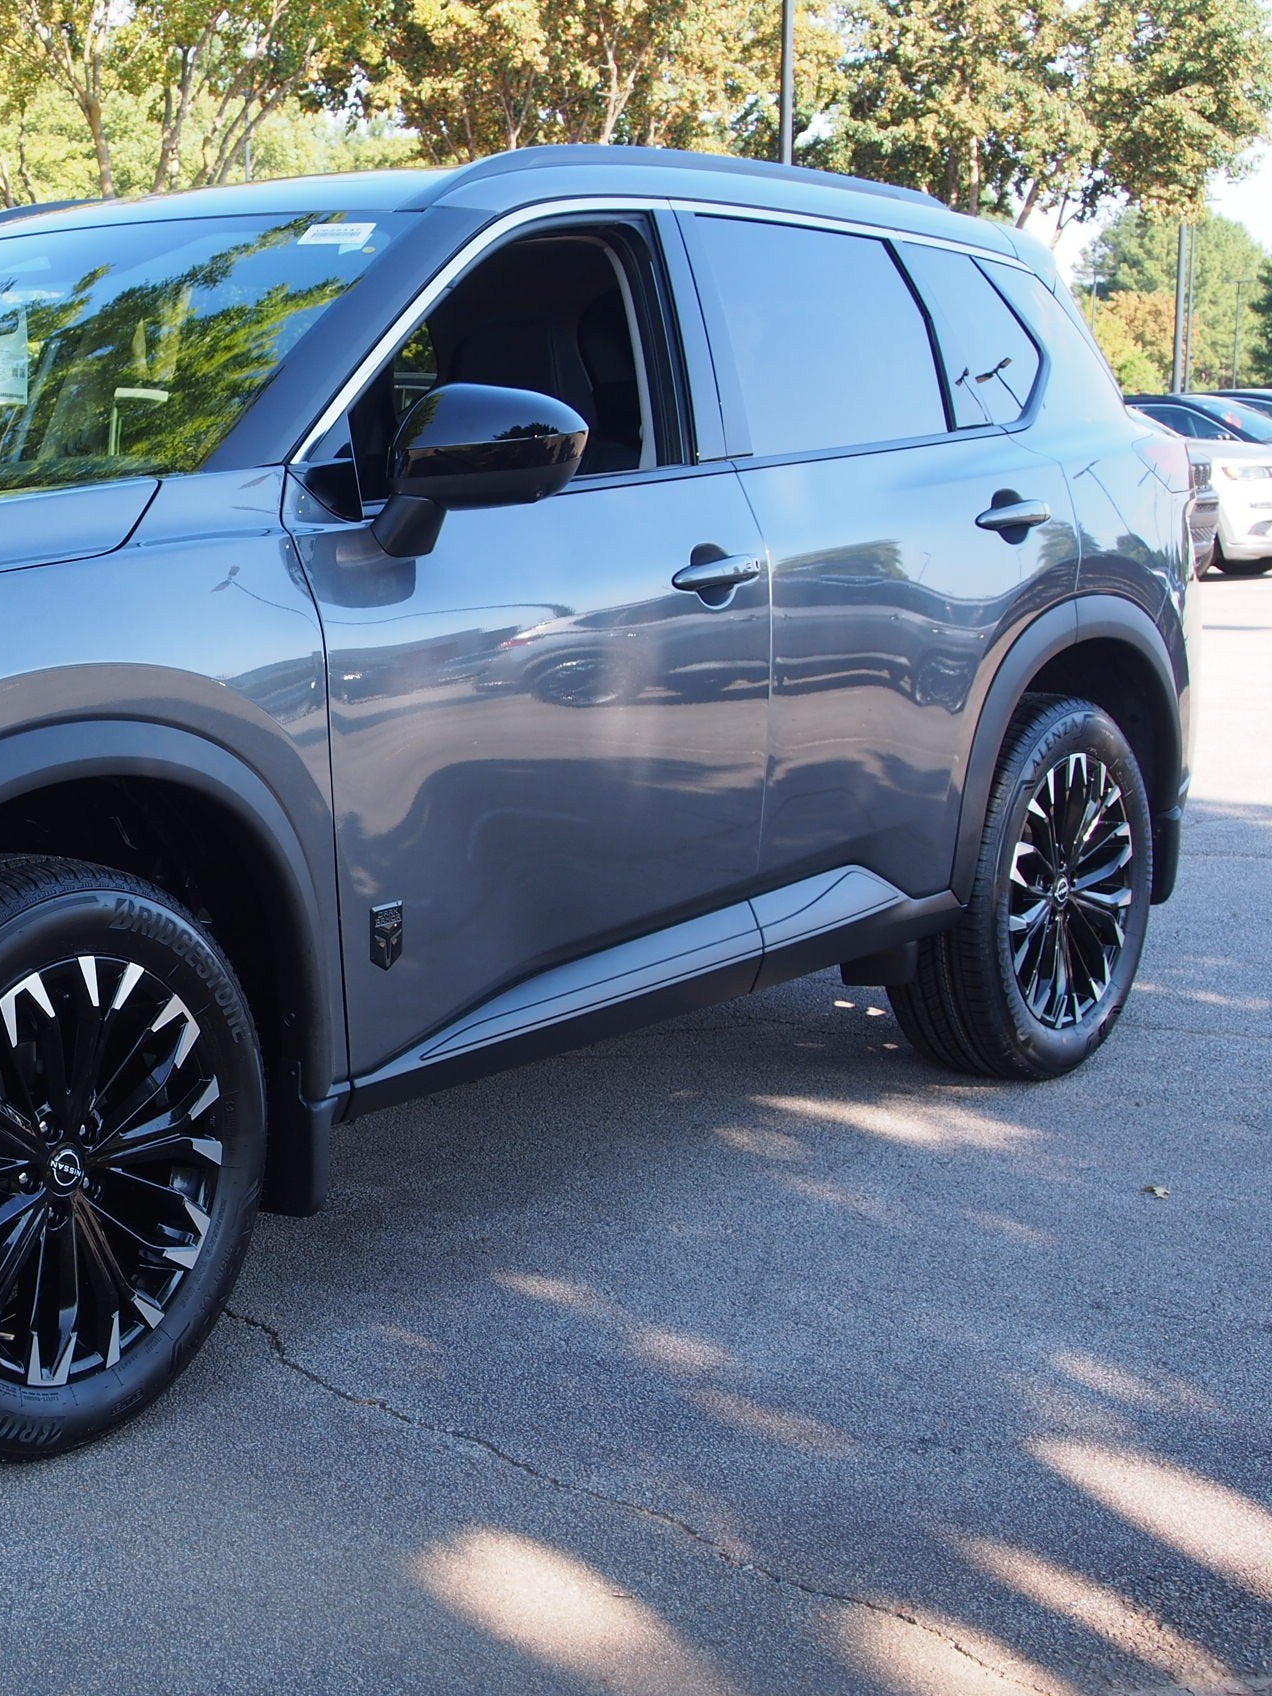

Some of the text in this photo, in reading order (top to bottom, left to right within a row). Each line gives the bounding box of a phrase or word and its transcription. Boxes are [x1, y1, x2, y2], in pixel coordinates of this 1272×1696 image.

[1032, 717, 1079, 772] ALENZA
[108, 898, 247, 1044] BRIDGESTONE
[50, 1160, 82, 1177] NISSAN
